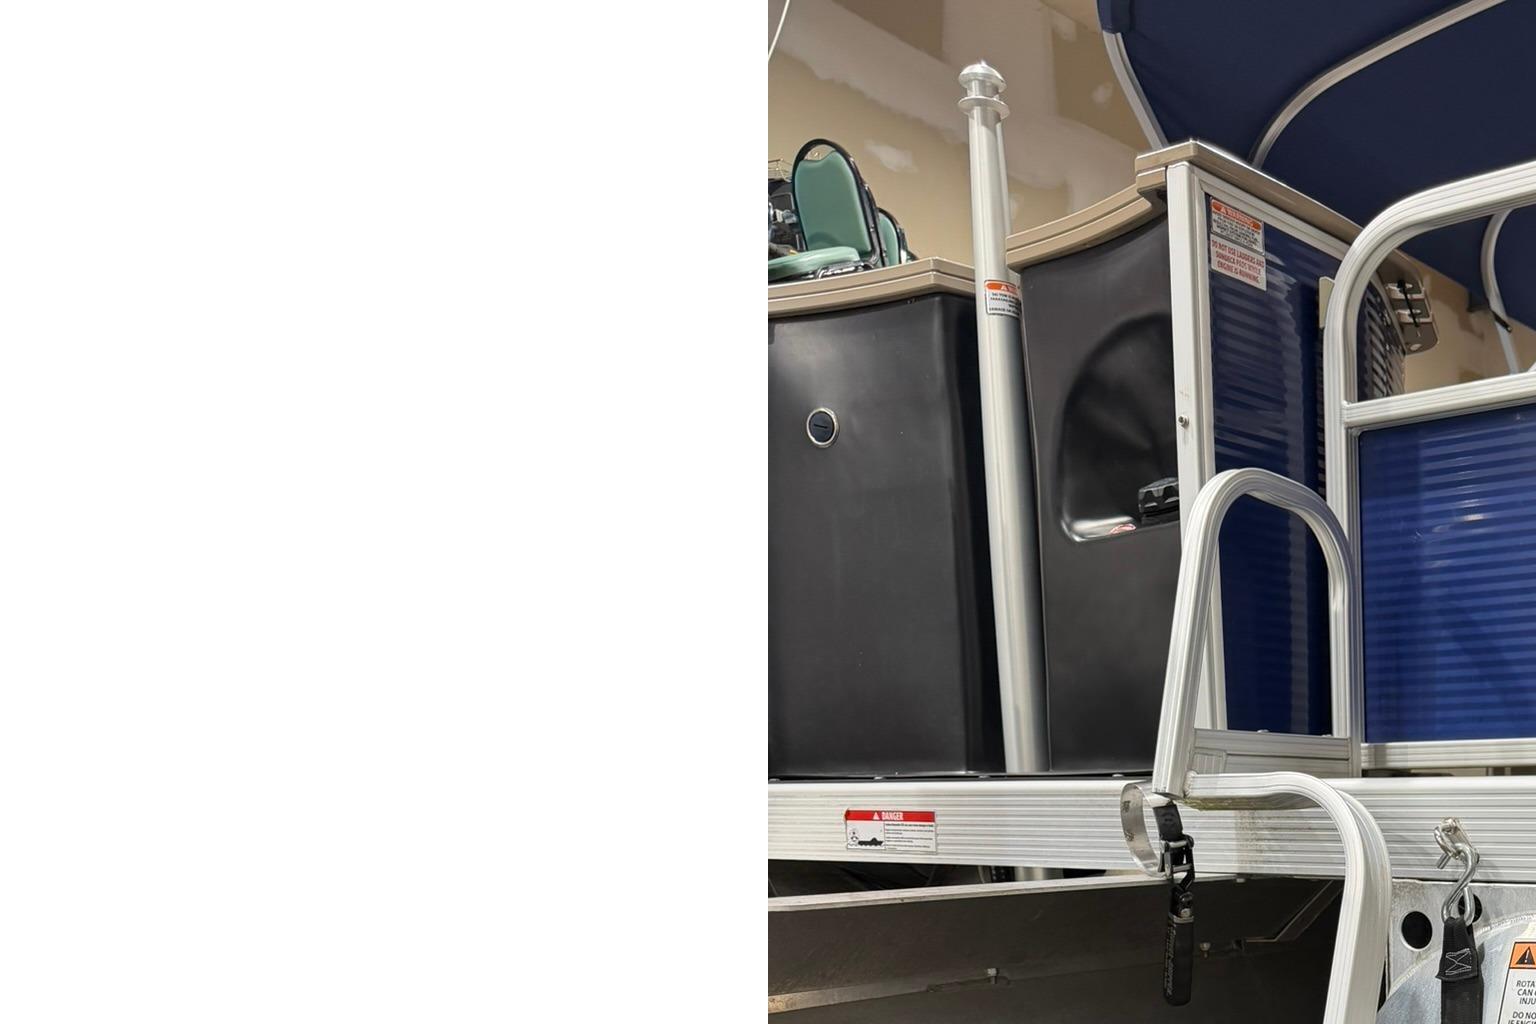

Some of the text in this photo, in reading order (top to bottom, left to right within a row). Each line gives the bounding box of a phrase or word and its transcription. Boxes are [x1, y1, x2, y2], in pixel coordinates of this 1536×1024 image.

[881, 811, 904, 821] DANGER
[1517, 988, 1533, 996] CAN
[1512, 1011, 1524, 1019] DO
